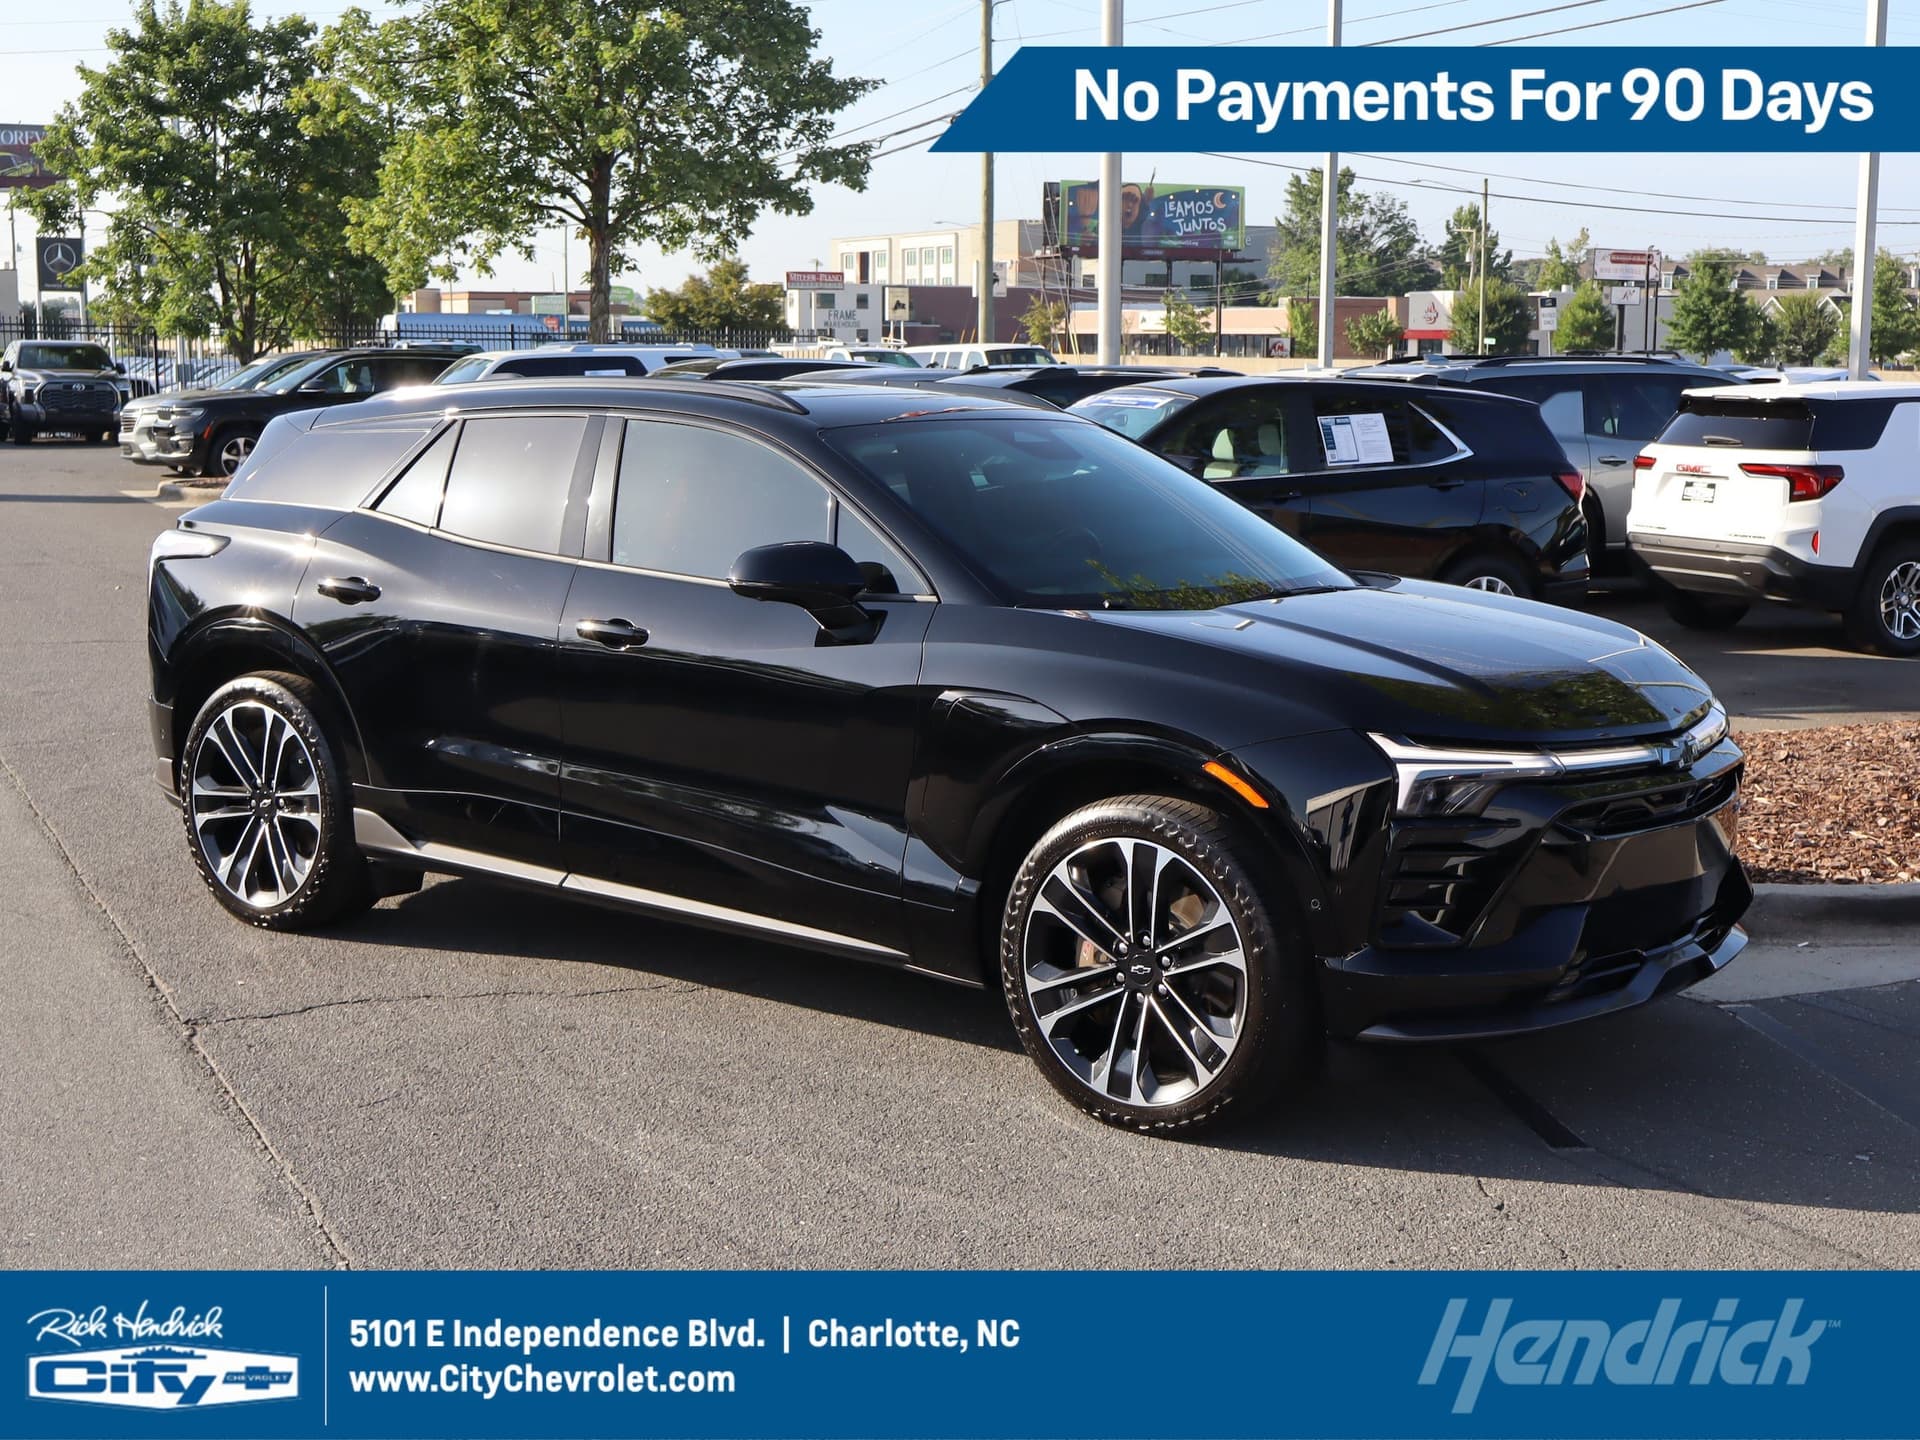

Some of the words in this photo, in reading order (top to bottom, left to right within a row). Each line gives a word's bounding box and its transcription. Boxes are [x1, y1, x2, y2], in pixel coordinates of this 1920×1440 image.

[1164, 200, 1214, 218] LEAMOS
[828, 310, 857, 321] FRAME
[1676, 463, 1712, 474] GMC
